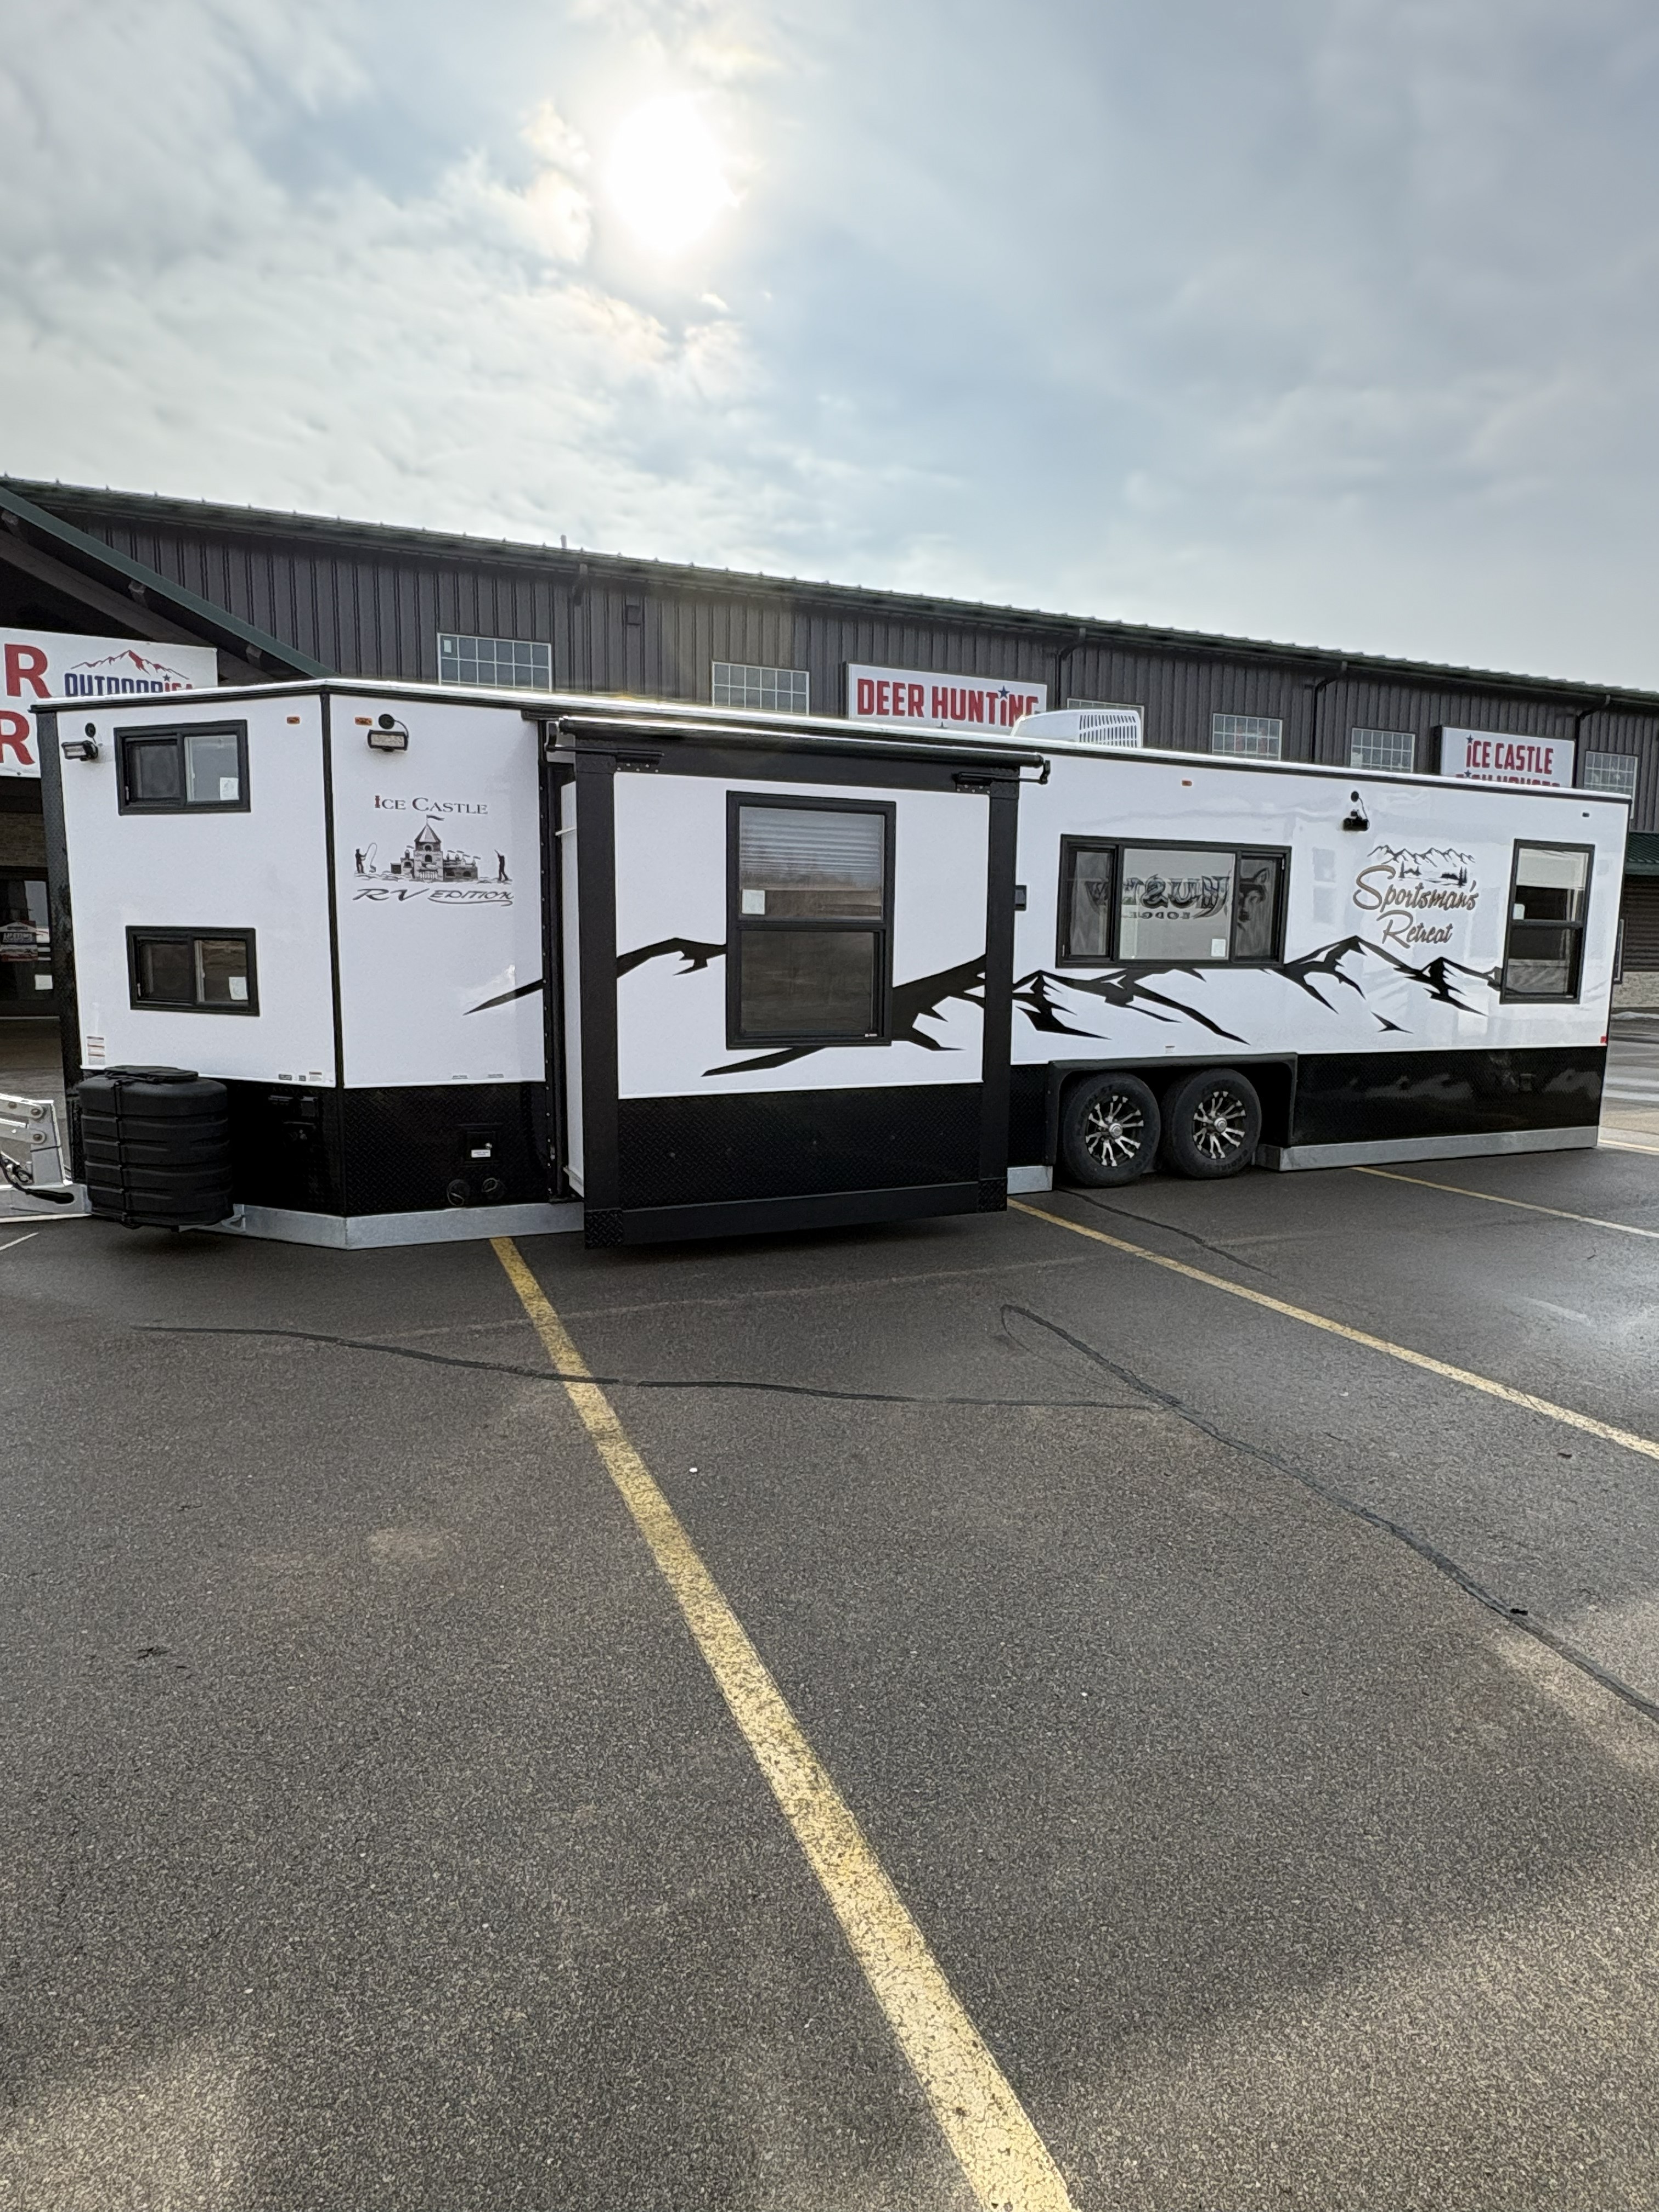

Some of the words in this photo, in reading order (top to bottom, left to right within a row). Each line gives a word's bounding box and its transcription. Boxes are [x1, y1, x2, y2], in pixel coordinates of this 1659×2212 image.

[857, 678, 924, 718] DEER
[1494, 743, 1554, 775] CASTLE
[352, 888, 430, 901] RV
[428, 890, 515, 907] EDITION
[1353, 865, 1480, 913] Sportsman's
[1376, 910, 1454, 949] Retreat
